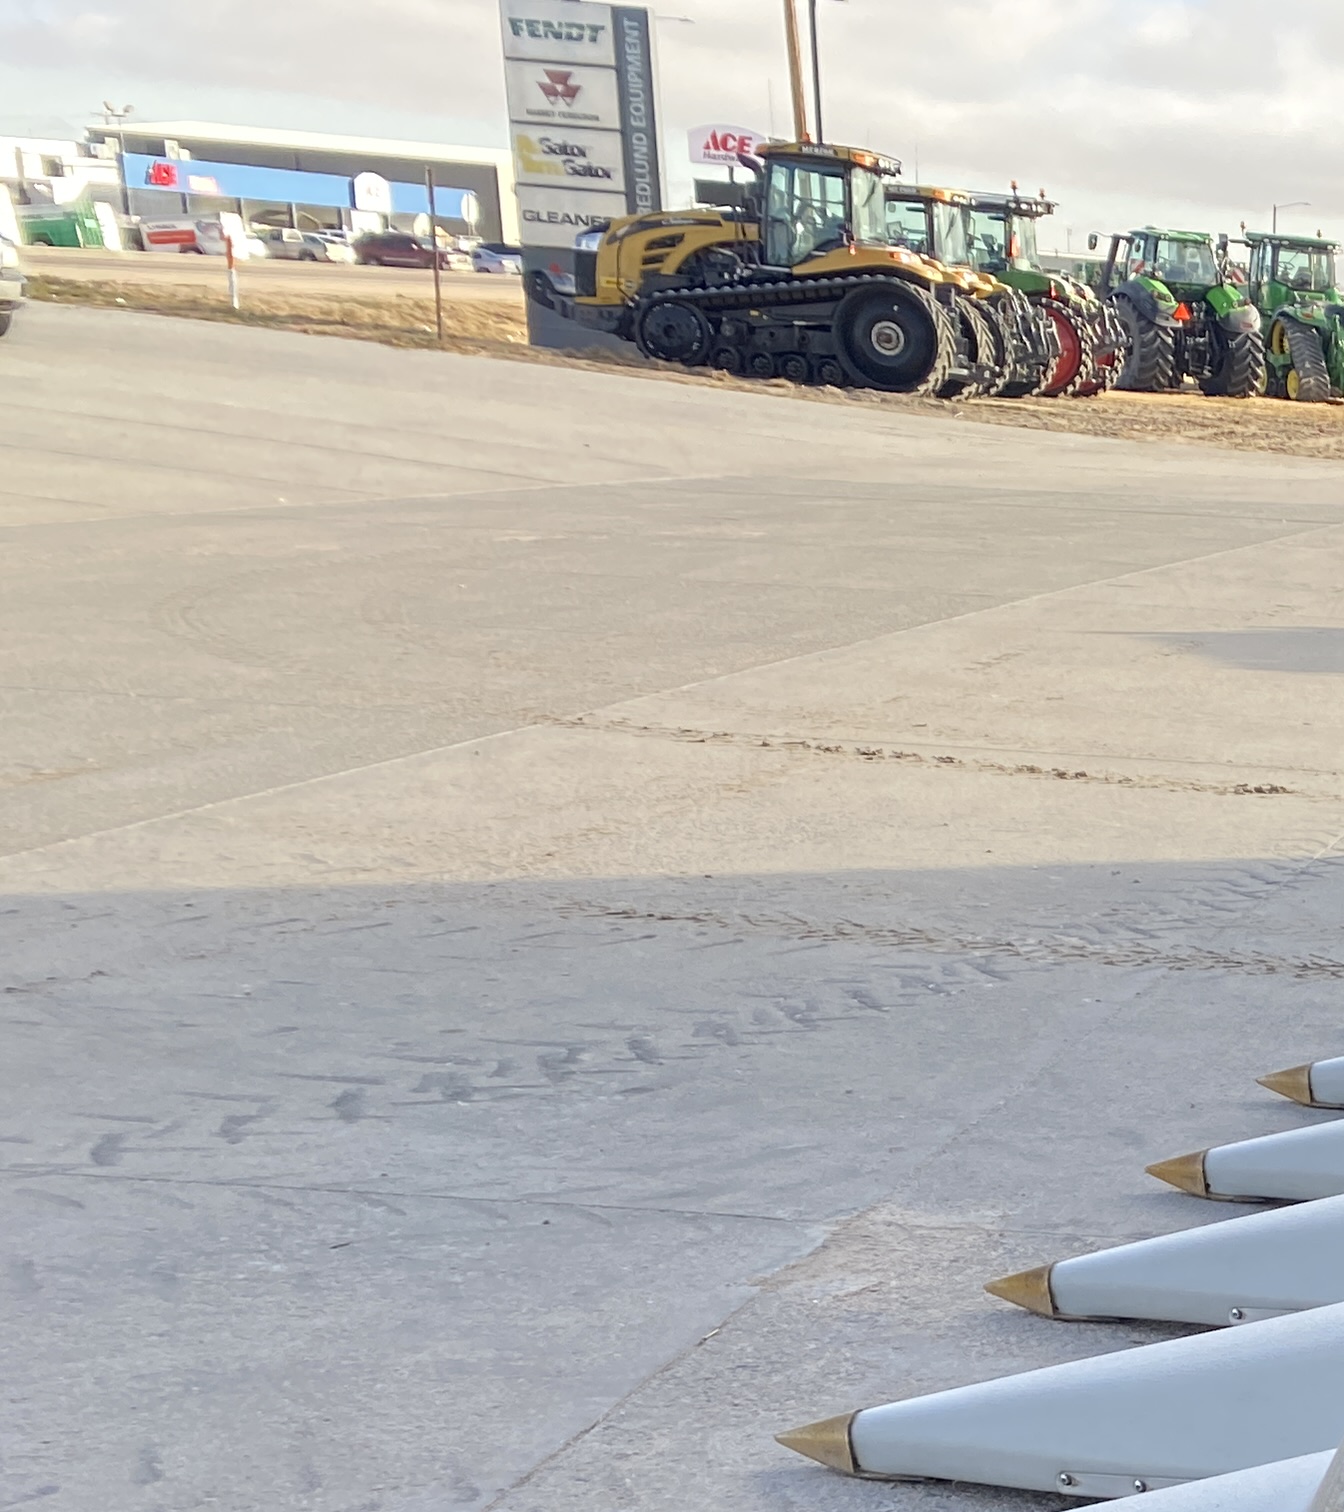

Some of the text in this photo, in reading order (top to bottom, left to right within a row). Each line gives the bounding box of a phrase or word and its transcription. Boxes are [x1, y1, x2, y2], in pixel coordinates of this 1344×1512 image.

[508, 17, 605, 43] FENDT
[623, 17, 647, 127] EQUIPMENT
[703, 129, 752, 153] ACE
